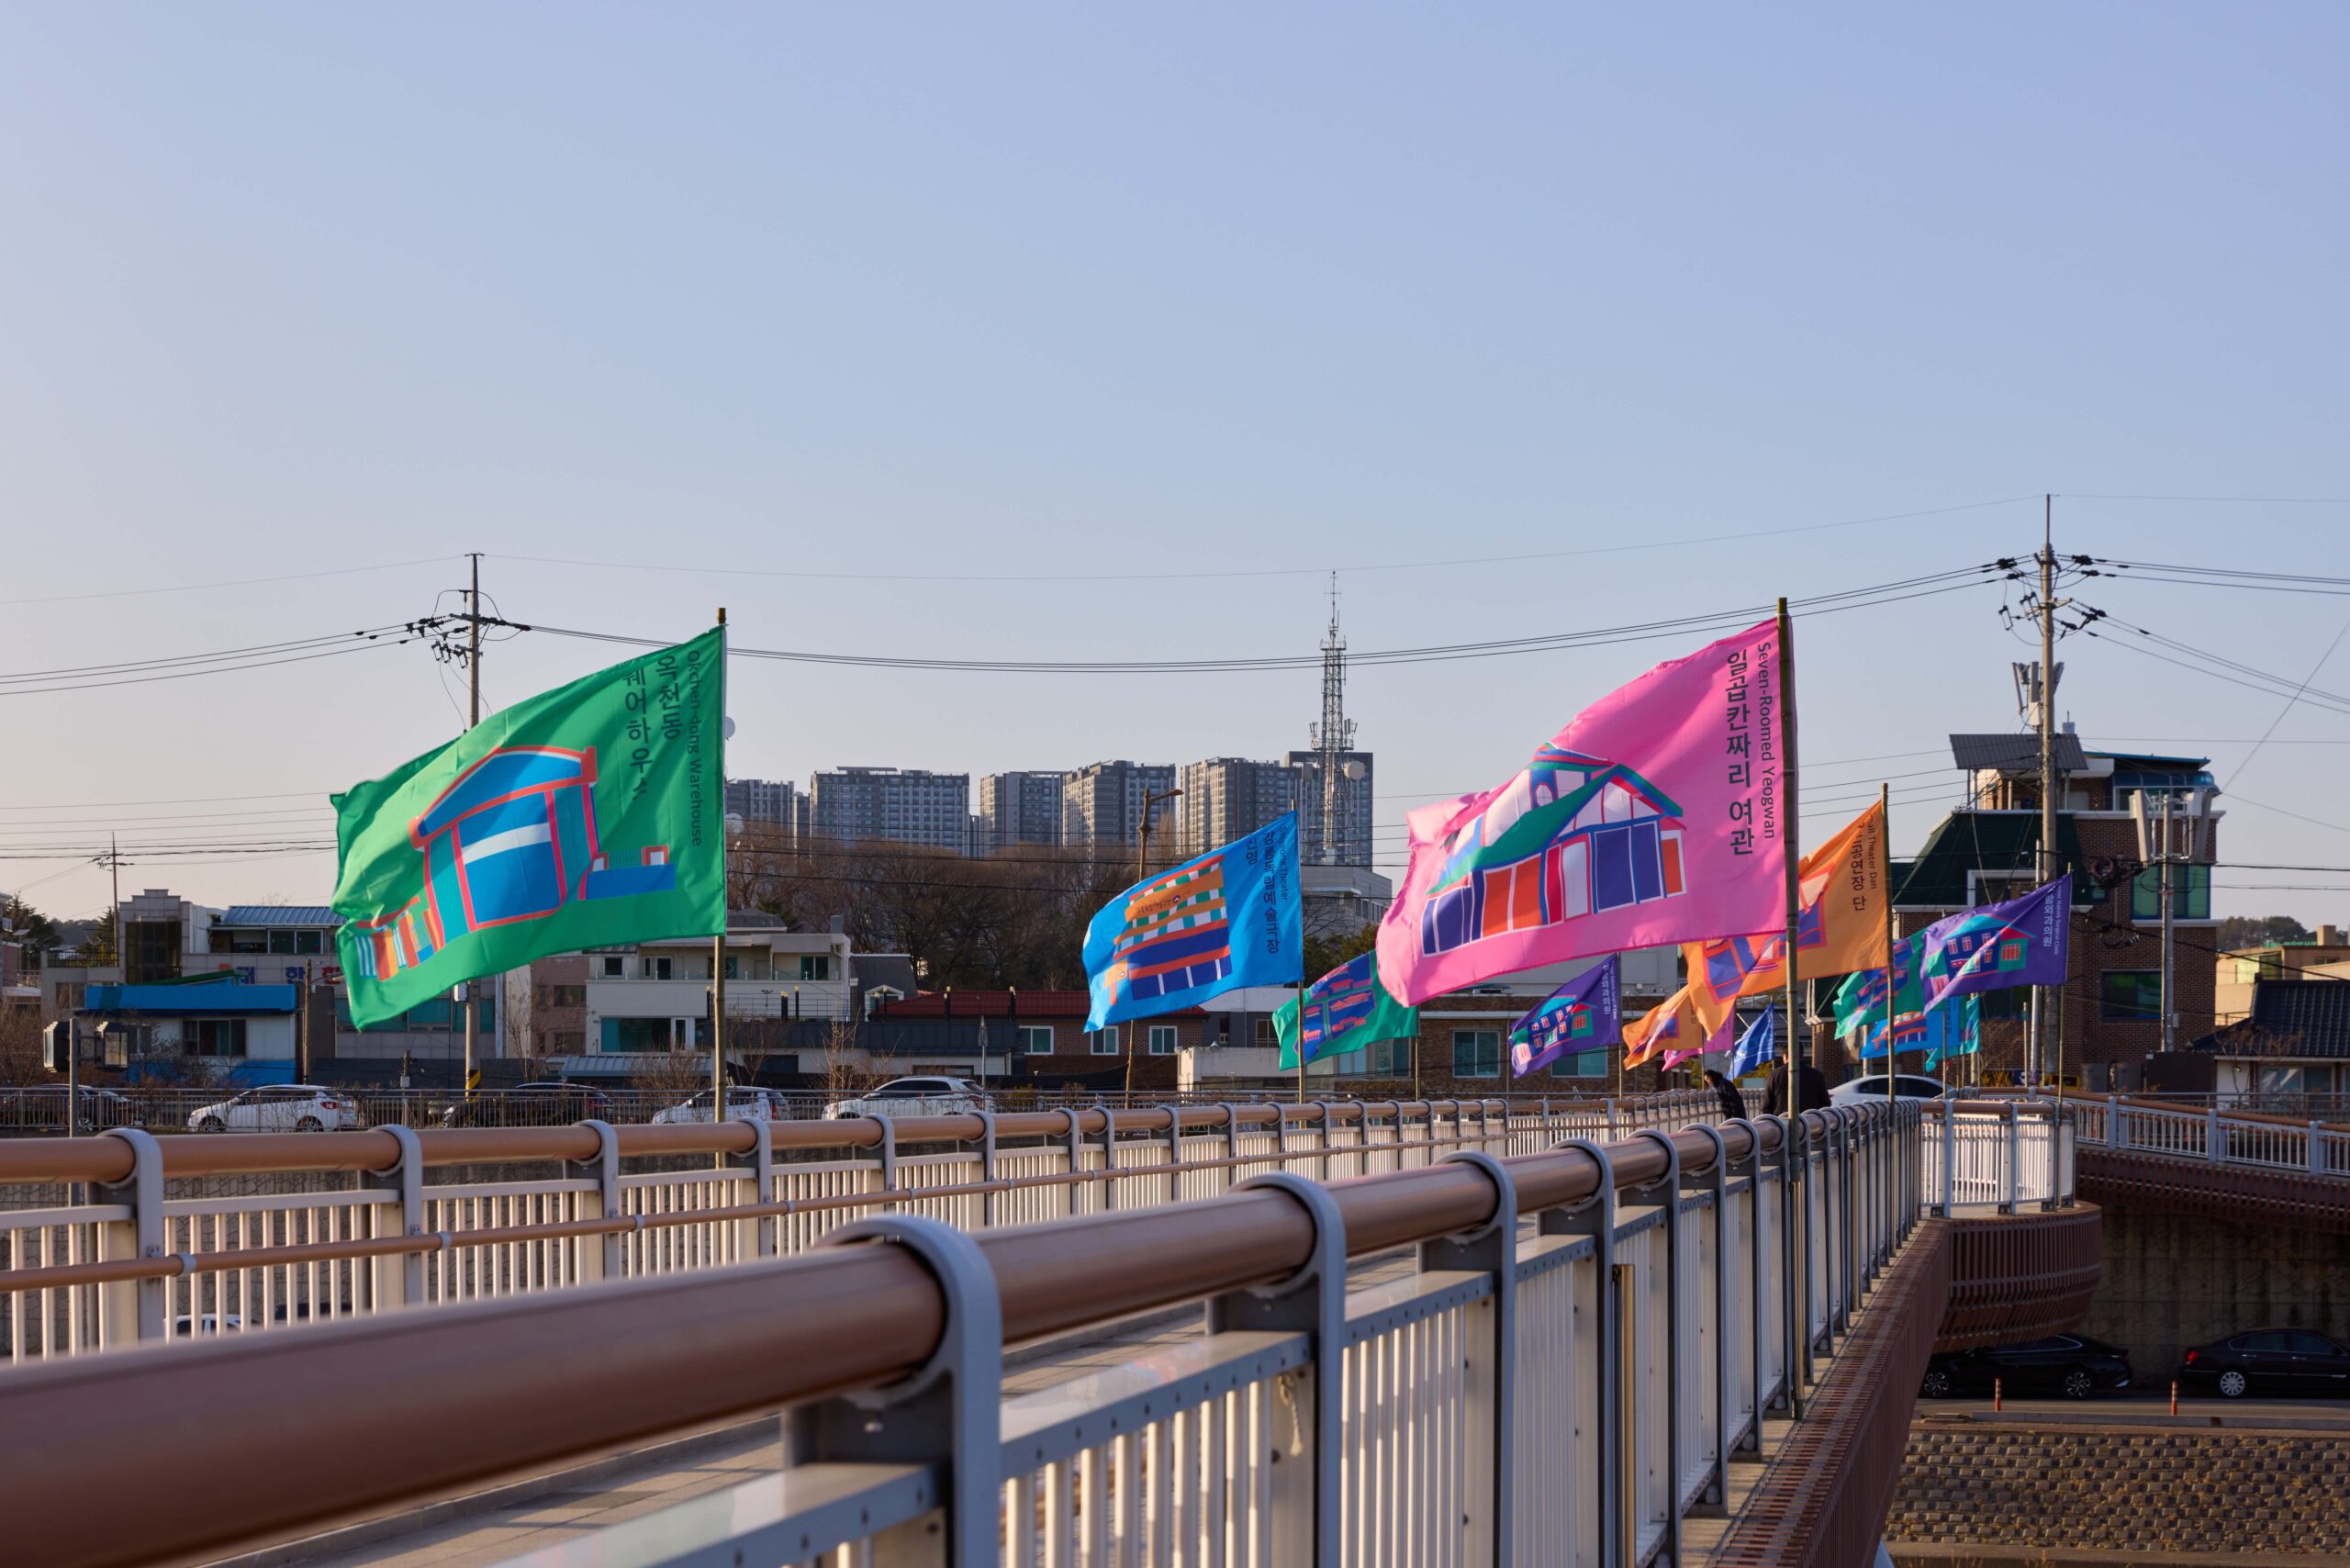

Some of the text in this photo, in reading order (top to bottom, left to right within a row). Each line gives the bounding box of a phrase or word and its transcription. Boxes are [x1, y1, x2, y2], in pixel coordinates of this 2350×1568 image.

[655, 655, 683, 740] 옥천동
[687, 650, 704, 846] Okchen-dong Warehouse
[1726, 649, 1755, 856] 일곱칸짜리 여관
[1757, 642, 1775, 839] Seven-Roomed Yeogwan
[1868, 835, 1876, 868] Theater
[1869, 871, 1877, 890] Dan
[1281, 867, 1289, 902] Theater
[1852, 895, 1866, 912] 단
